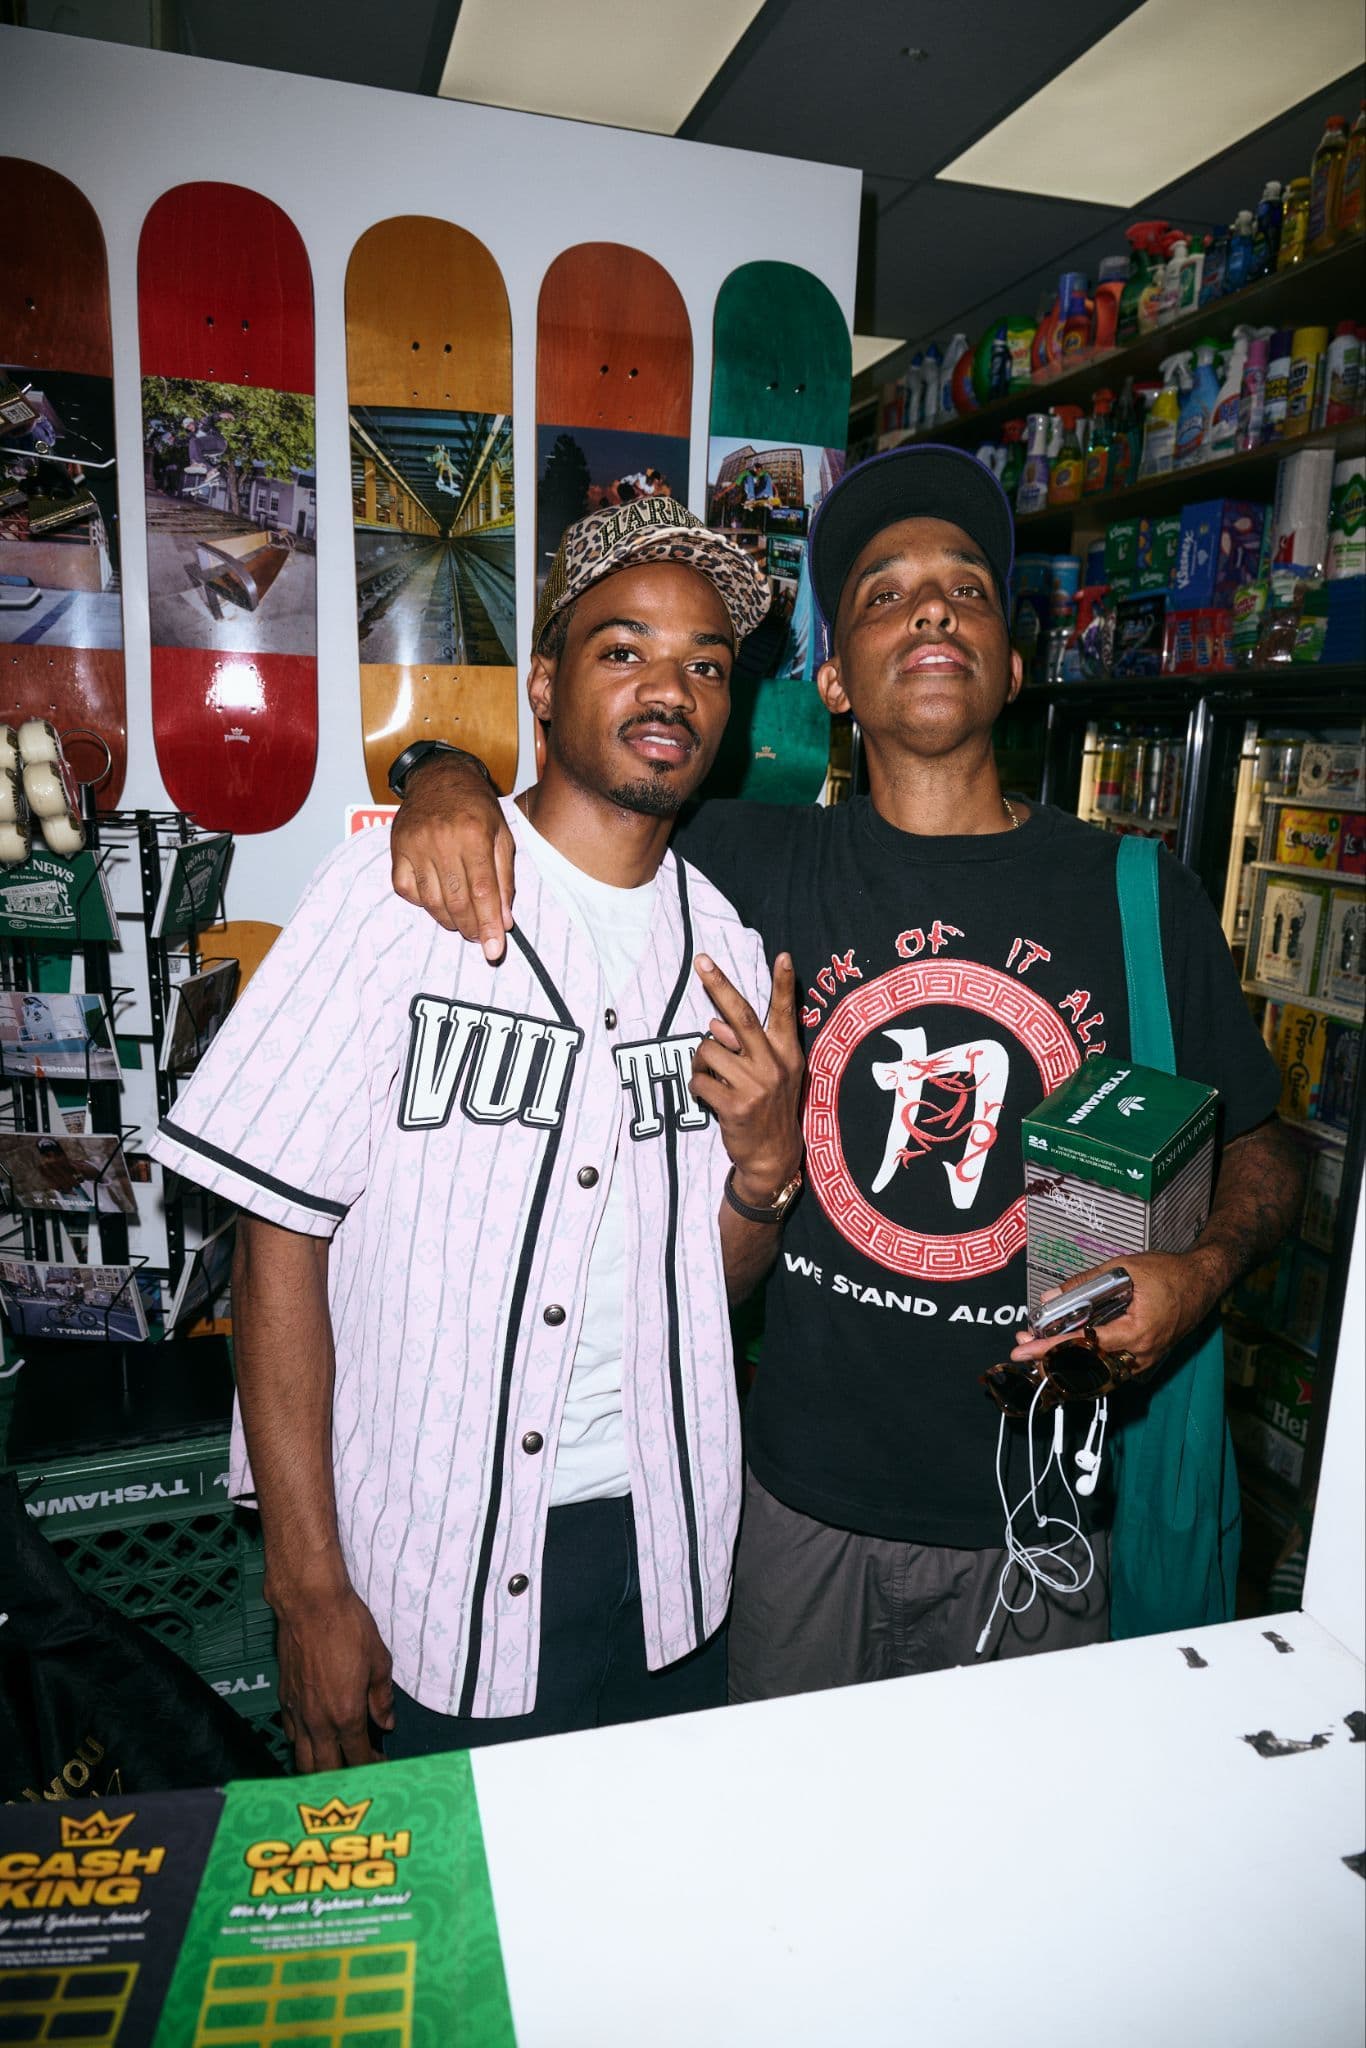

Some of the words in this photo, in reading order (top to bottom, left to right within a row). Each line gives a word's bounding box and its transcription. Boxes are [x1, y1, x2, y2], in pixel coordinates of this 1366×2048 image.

[1175, 529, 1194, 590] Kleenex
[32, 859, 75, 883] NEWS
[800, 949, 863, 1028] SICK
[895, 919, 966, 959] OF
[1004, 936, 1052, 975] IT
[1066, 1069, 1132, 1126] TYSHAWN
[1028, 1134, 1049, 1148] 24
[783, 1252, 823, 1286] WE
[831, 1273, 939, 1317] STAND
[948, 1305, 1028, 1326] ALON
[24, 1479, 190, 1518] TYSHAWN
[0, 1847, 166, 1880] CASH
[244, 1830, 412, 1870] CASH
[0, 1876, 143, 1909] KING
[250, 1858, 398, 1898] KING
